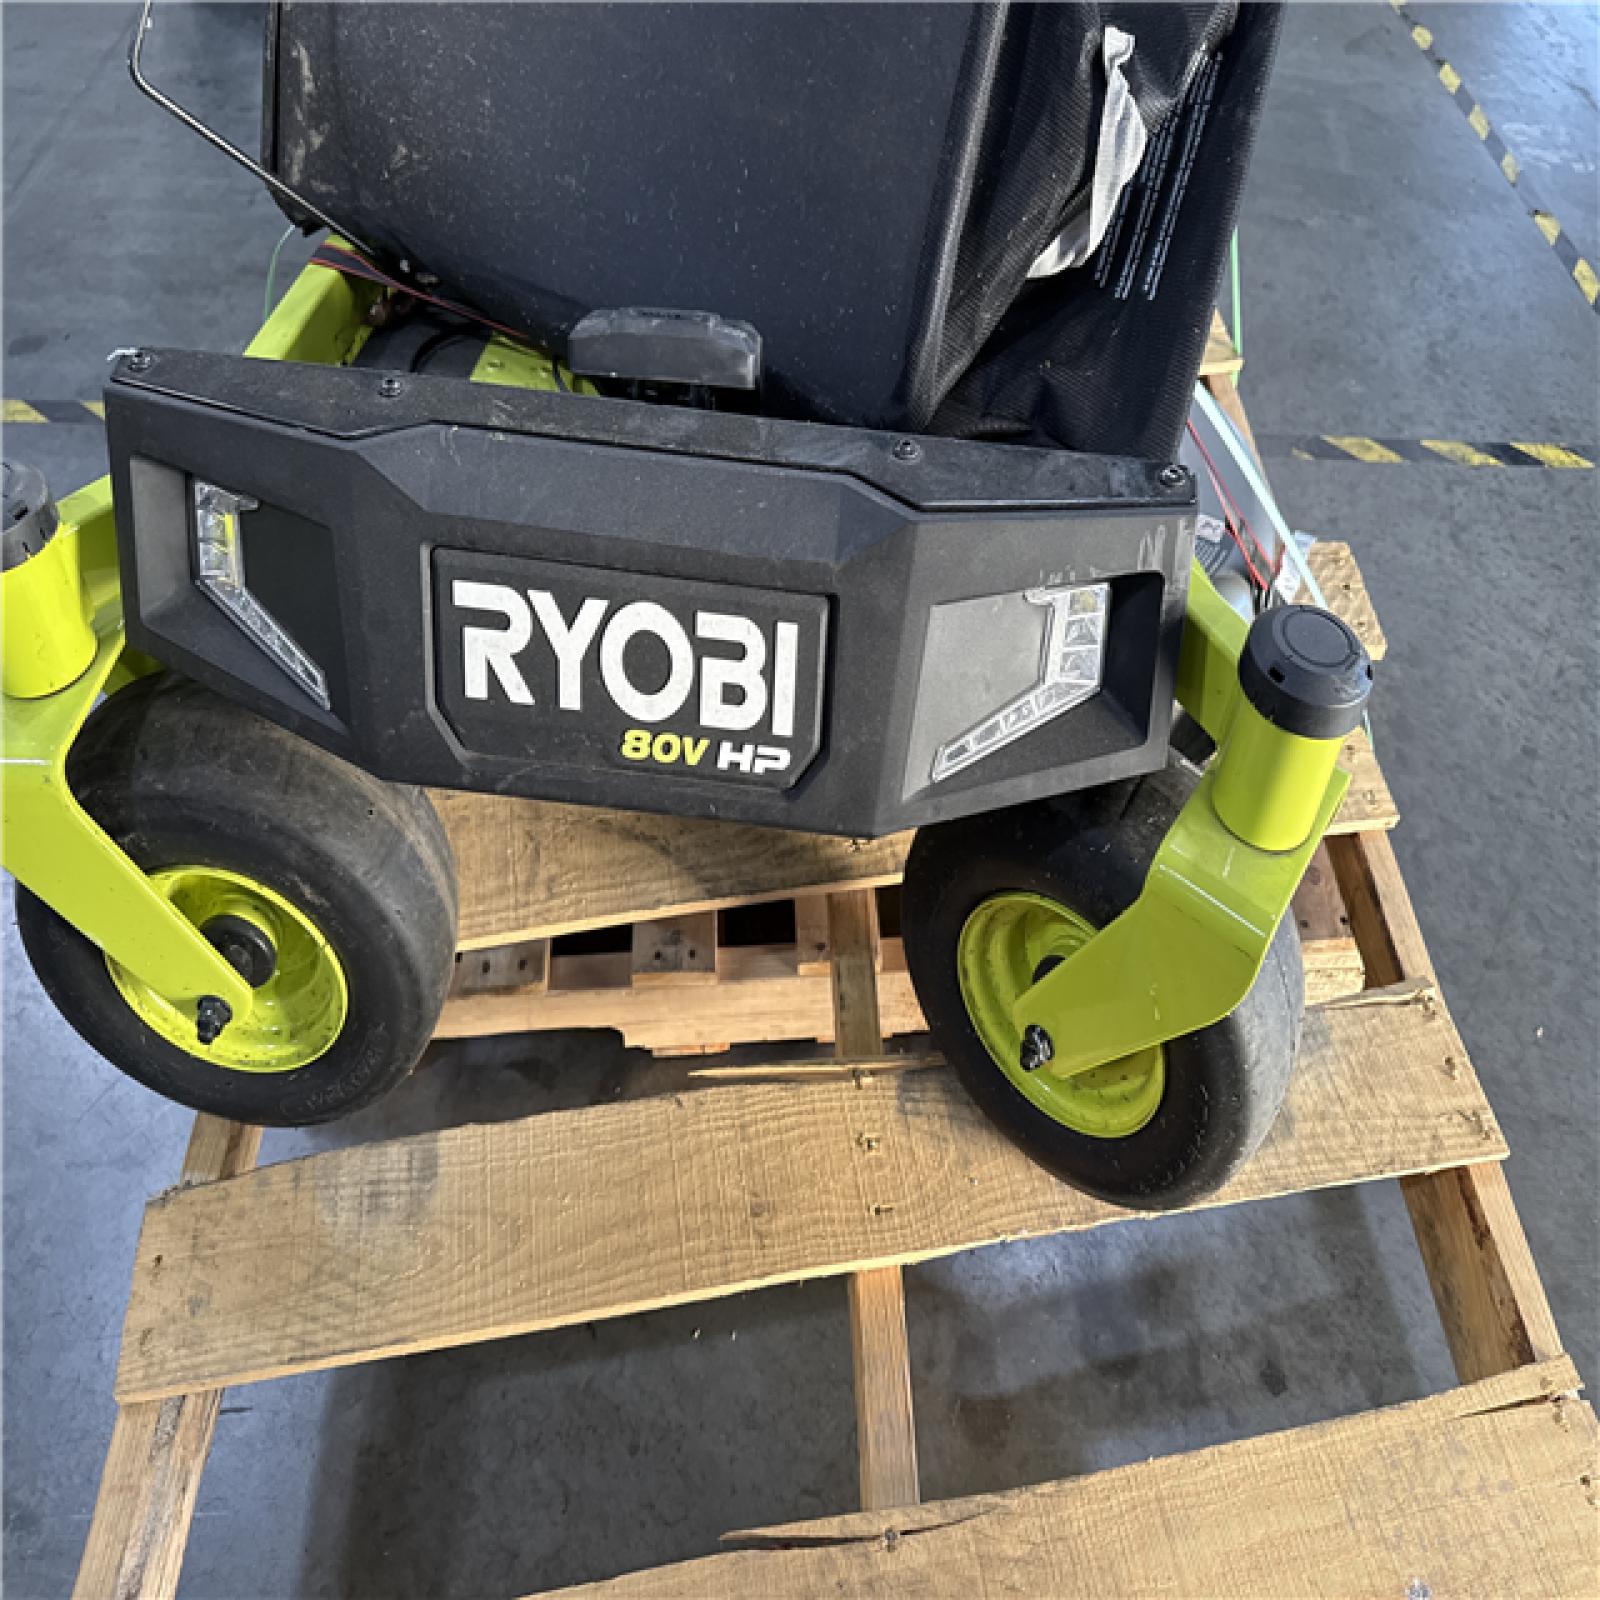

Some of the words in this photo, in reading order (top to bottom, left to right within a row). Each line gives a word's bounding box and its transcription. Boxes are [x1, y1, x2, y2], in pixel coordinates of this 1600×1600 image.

[452, 579, 798, 738] RYOBI
[621, 729, 709, 765] 80V
[717, 741, 792, 775] HP
